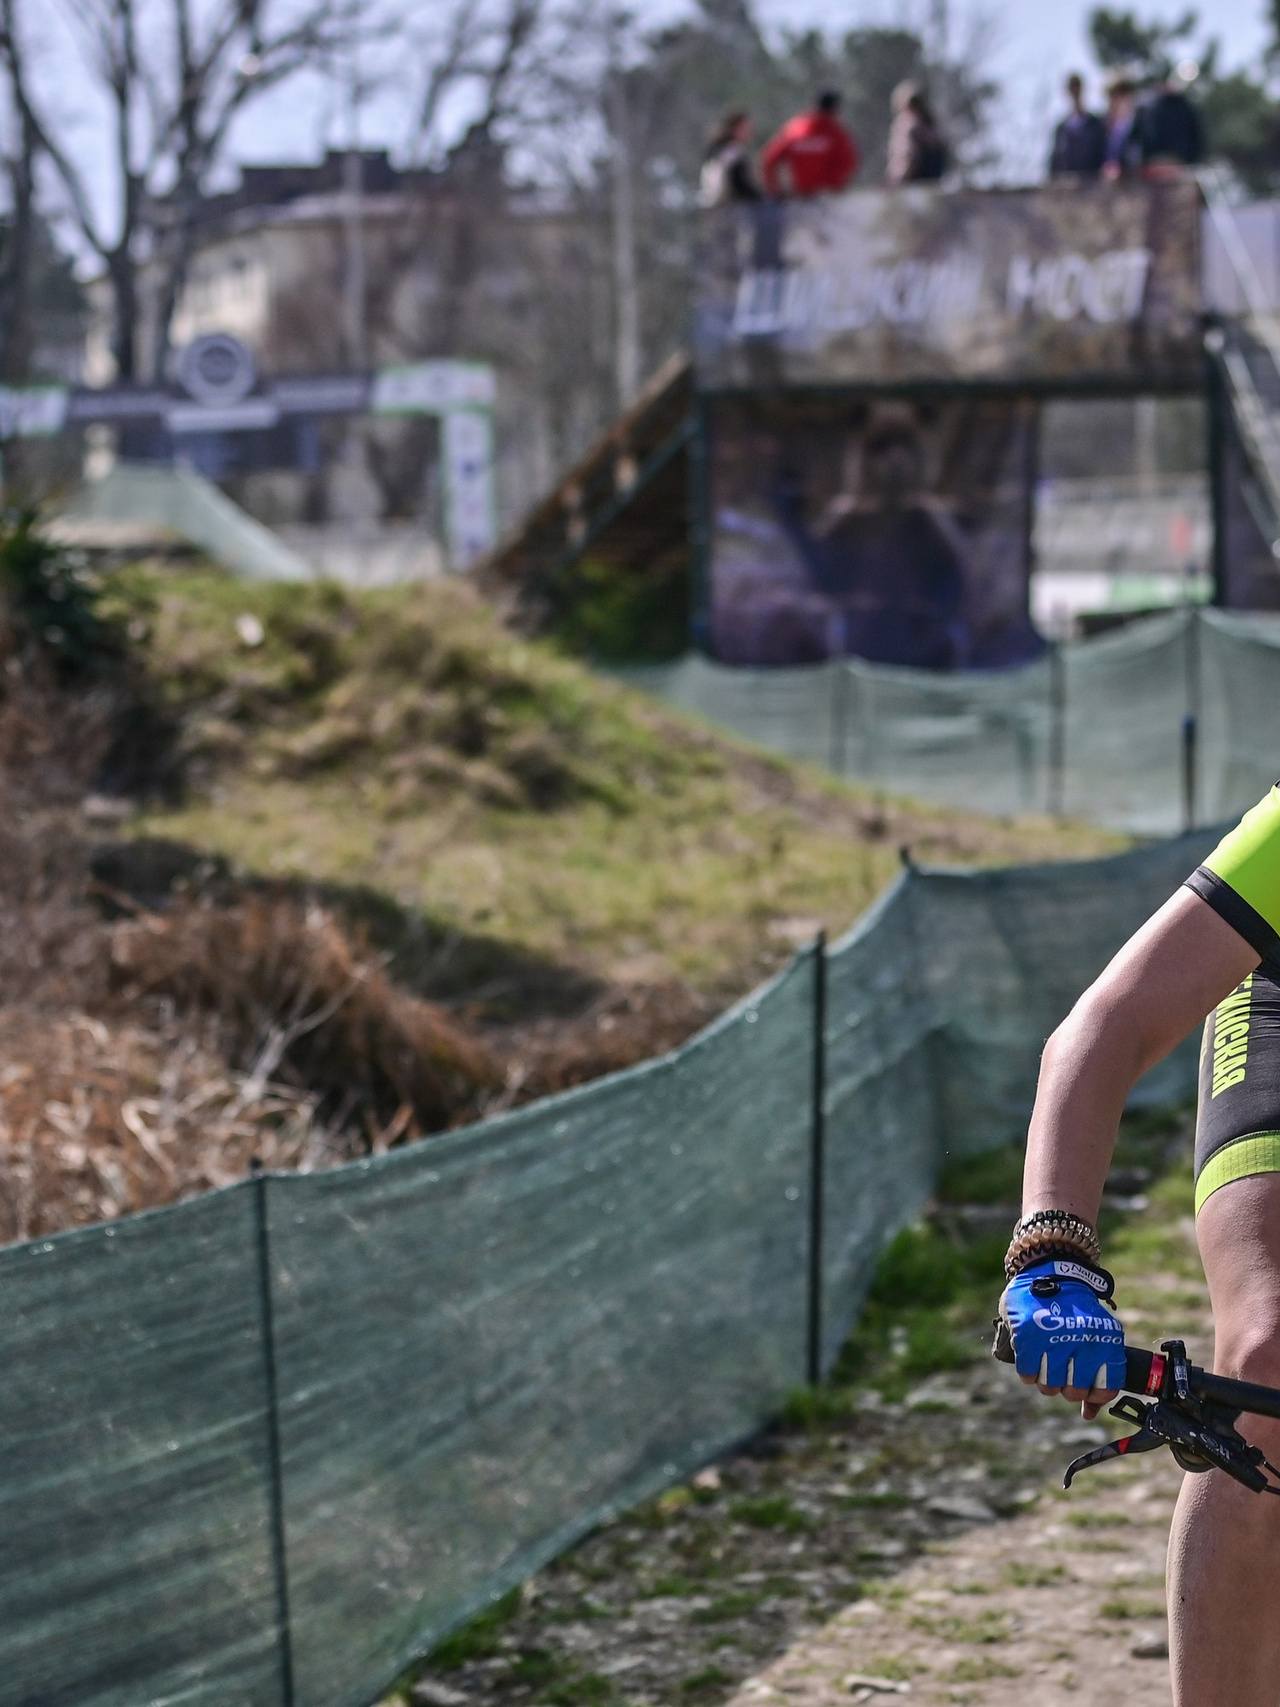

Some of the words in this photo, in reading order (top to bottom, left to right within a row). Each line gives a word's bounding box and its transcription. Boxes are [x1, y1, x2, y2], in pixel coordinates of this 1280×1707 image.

[1071, 1264, 1106, 1287] Nalini
[1065, 1315, 1123, 1332] GAZPRO
[1049, 1333, 1123, 1345] COLNAGO
